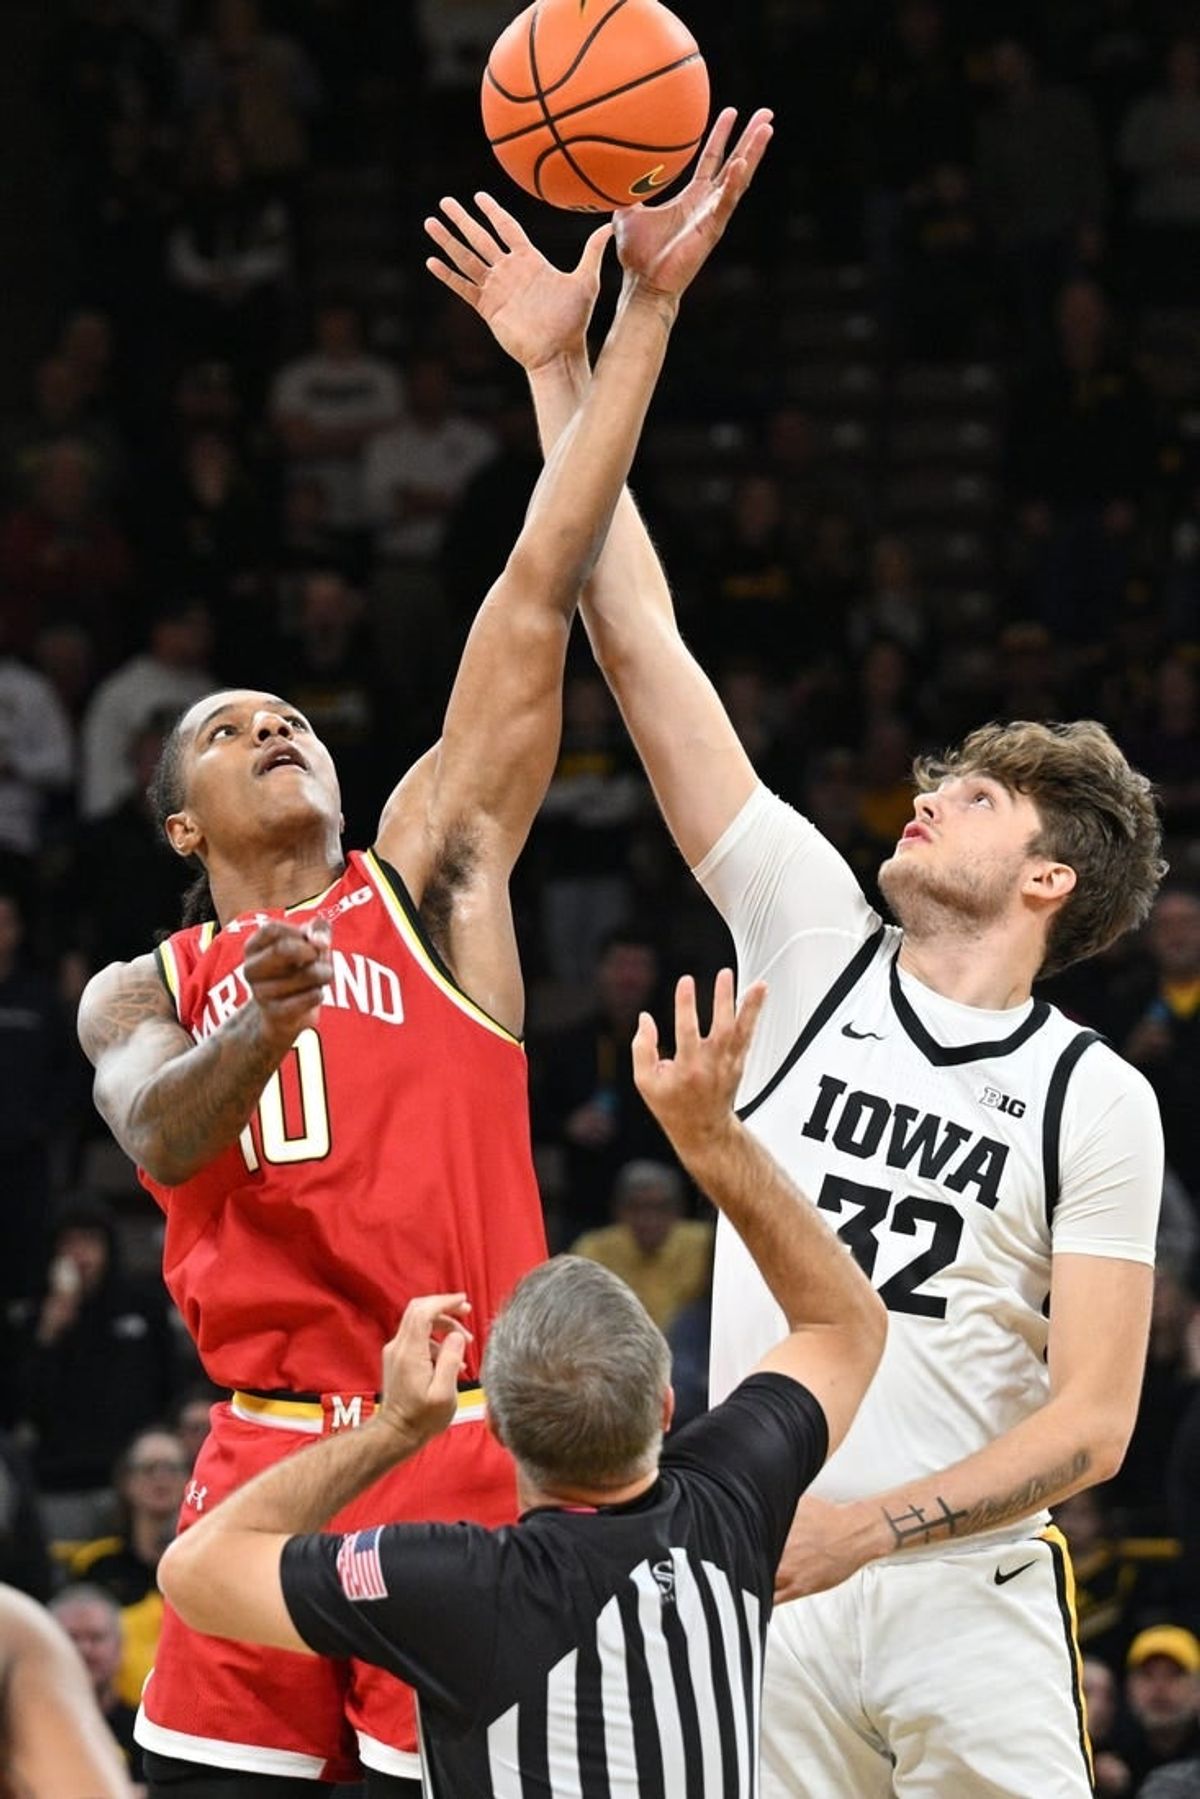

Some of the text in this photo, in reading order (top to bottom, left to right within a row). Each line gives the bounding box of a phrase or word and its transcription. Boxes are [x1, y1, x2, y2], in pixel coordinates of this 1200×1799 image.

[192, 950, 404, 1046] ARND
[801, 1074, 1010, 1211] IOWA
[979, 1086, 1026, 1118] BIG
[817, 1173, 964, 1320] 32
[331, 1395, 362, 1429] M
